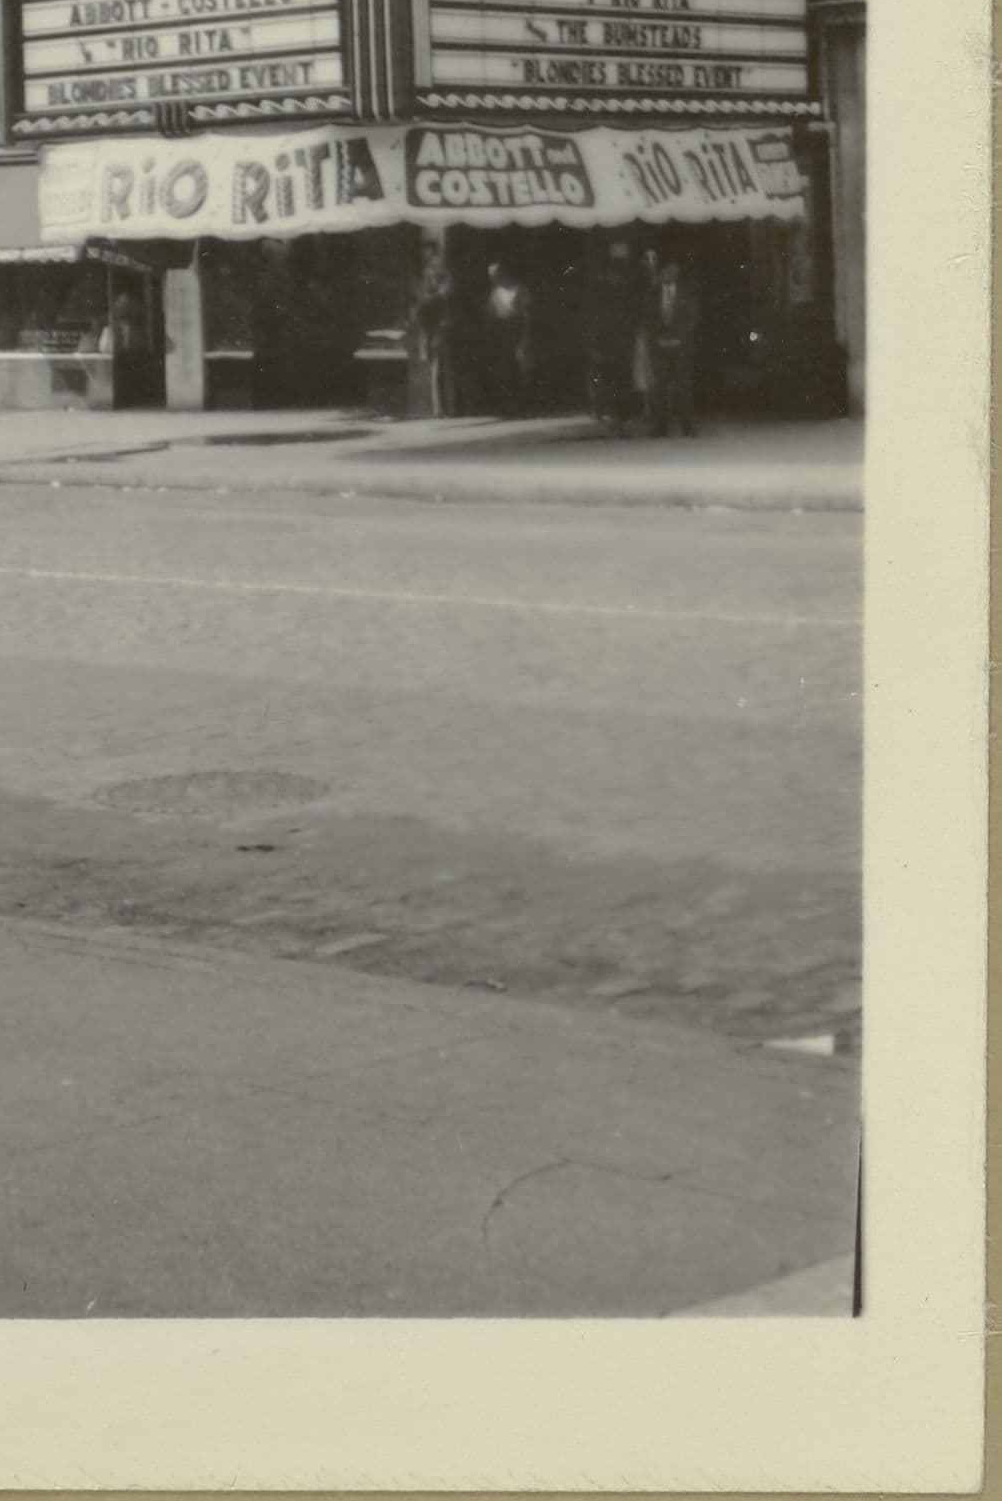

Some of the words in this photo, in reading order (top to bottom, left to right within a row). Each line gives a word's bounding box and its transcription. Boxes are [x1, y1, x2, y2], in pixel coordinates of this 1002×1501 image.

[556, 19, 588, 45] THE
[603, 21, 702, 48] BUMSTEADS
[148, 69, 232, 97] BLESSED
[239, 61, 313, 90] EVENT
[616, 62, 685, 88] BLESSED
[416, 132, 543, 169] ABBOTT
[415, 169, 586, 205] COSTELLO
